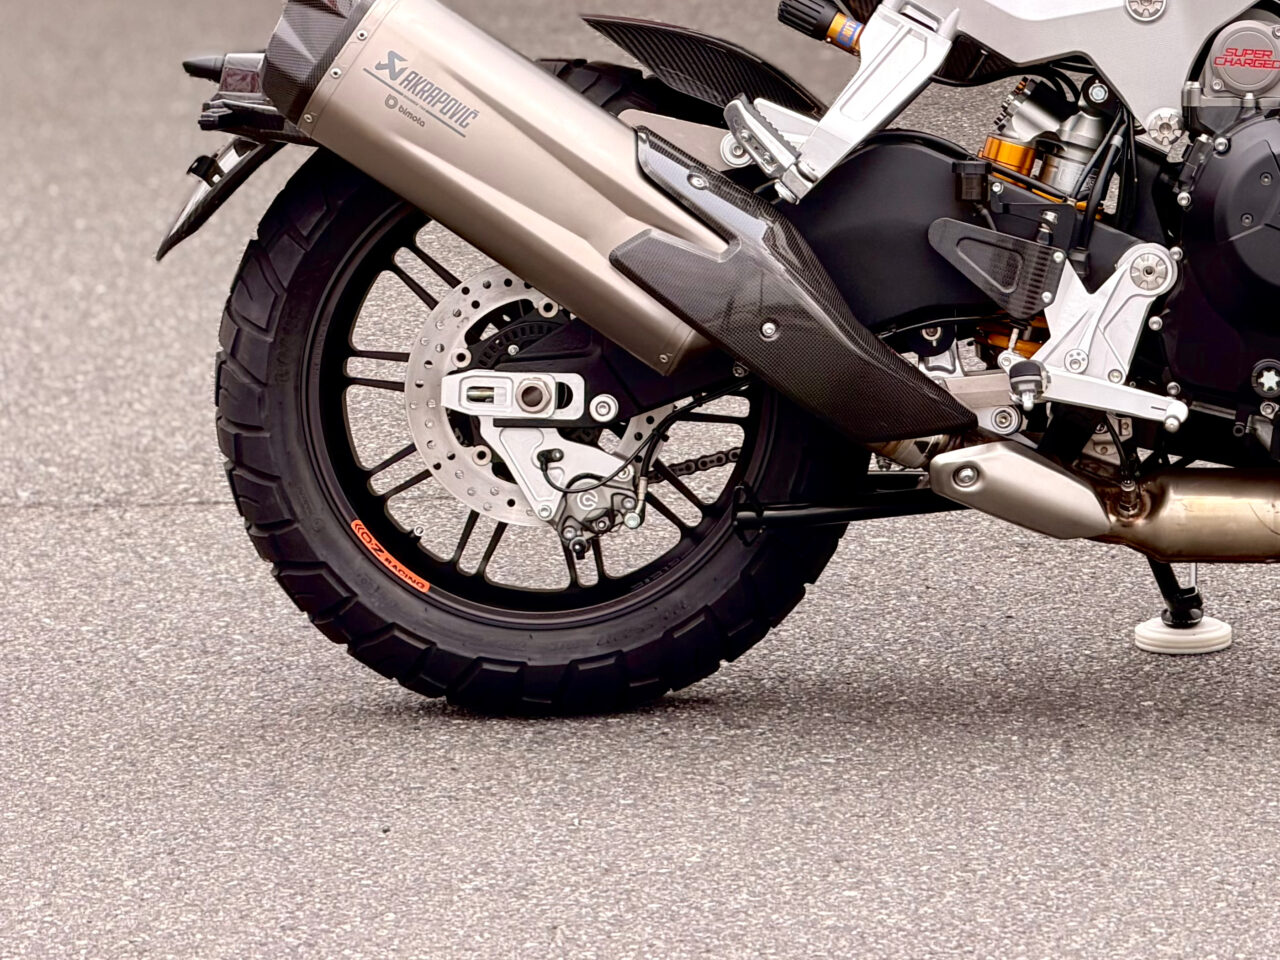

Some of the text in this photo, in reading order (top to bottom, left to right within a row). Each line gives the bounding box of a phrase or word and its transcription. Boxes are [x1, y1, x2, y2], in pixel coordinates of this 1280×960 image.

[1222, 47, 1274, 59] SUPER
[398, 104, 427, 128] bimota
[384, 557, 426, 589] RACING
